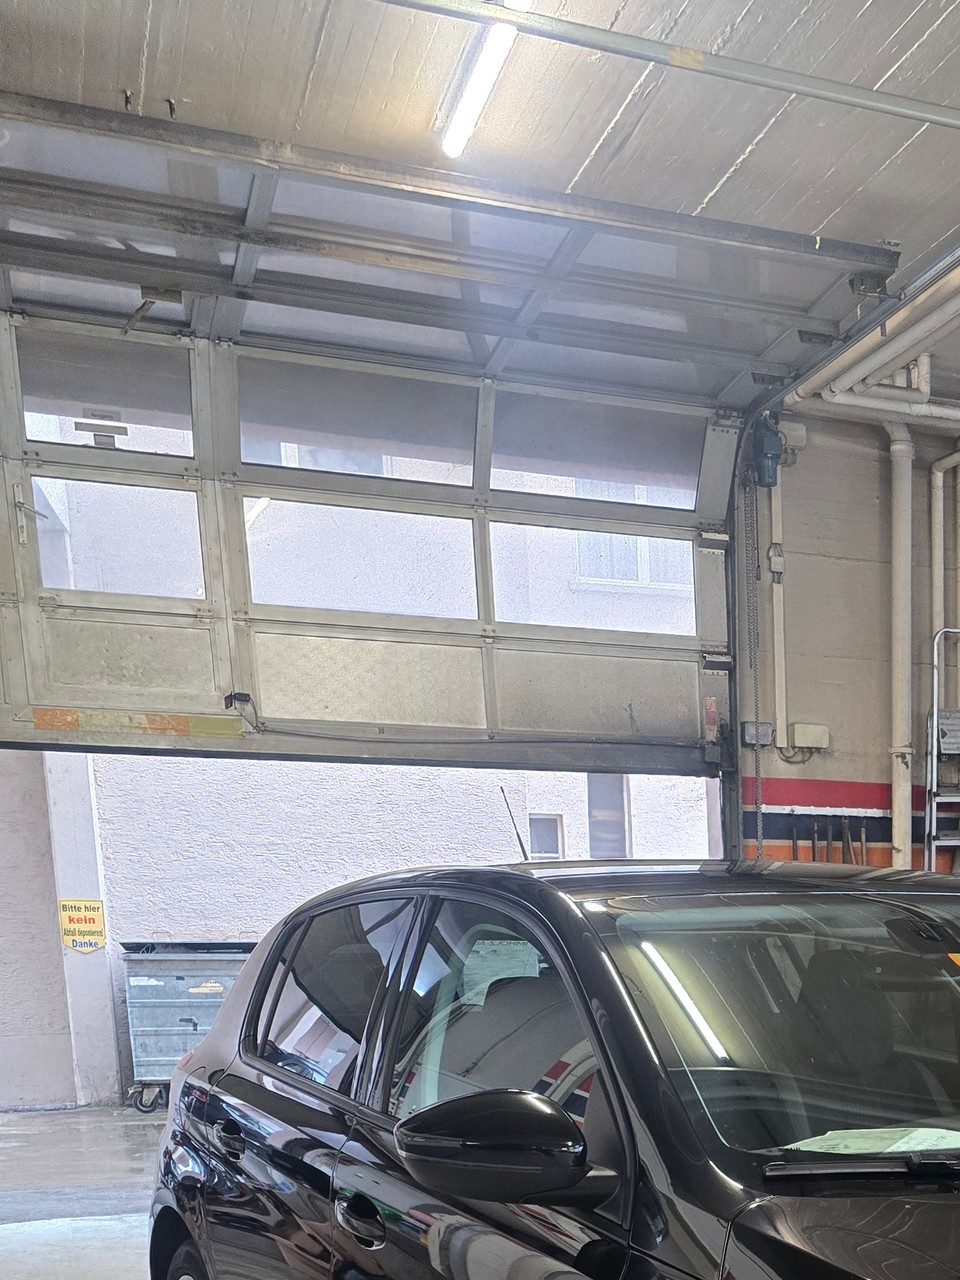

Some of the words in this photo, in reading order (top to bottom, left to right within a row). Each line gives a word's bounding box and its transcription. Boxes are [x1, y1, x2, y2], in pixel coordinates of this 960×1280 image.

[62, 904, 82, 913] Bitte
[84, 904, 100, 913] hier
[68, 915, 95, 924] kein
[72, 939, 98, 948] Danke
